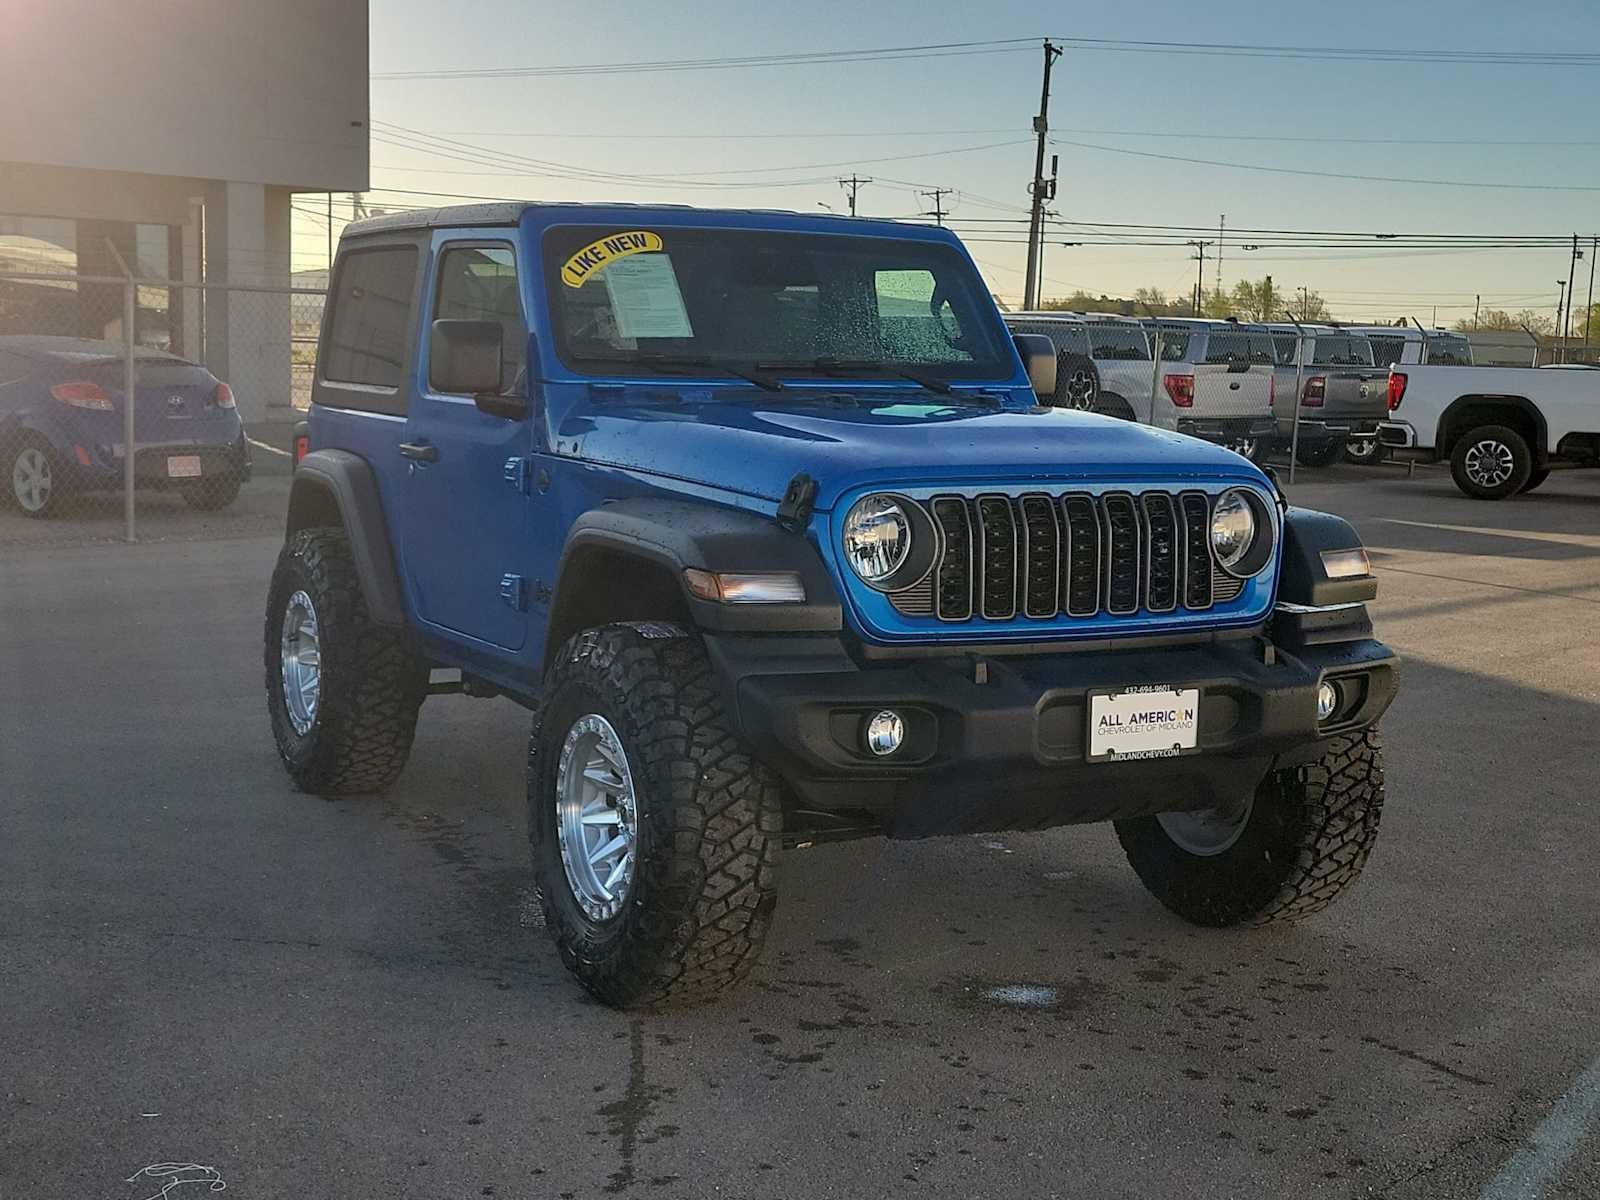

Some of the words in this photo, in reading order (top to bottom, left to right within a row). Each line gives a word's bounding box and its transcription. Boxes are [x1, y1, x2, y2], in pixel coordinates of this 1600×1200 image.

[567, 246, 606, 278] LIKE
[603, 233, 648, 255] NEW
[1098, 714, 1122, 727] ALL
[1098, 724, 1144, 736] CHEVROLET
[1146, 724, 1157, 732] OF
[1159, 721, 1193, 731] MIDLAND
